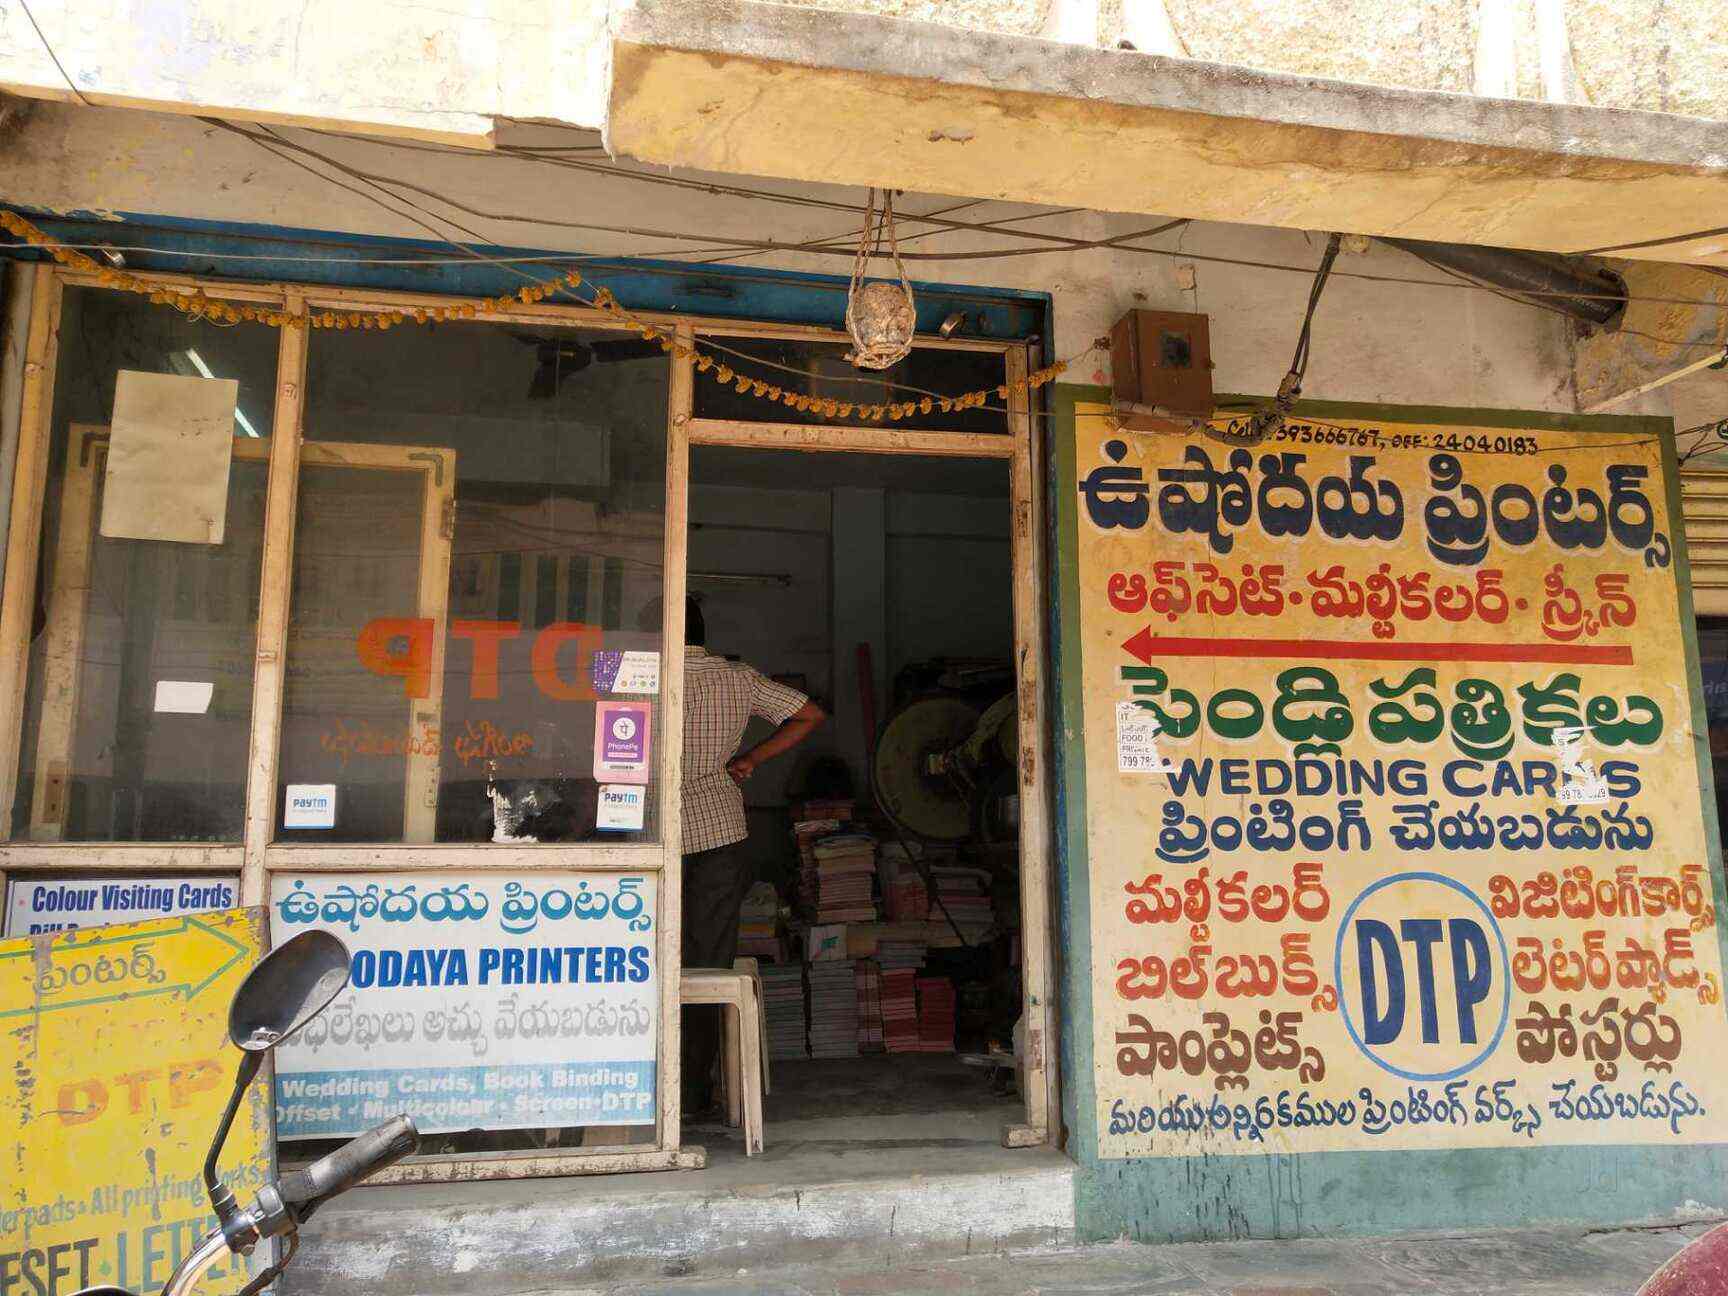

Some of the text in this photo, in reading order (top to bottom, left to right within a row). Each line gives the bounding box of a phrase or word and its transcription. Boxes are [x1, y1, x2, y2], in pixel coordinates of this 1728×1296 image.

[1433, 434, 1538, 455] 24040183
[1079, 439, 1671, 568] ఉషోదయ ప్రింటర్స్
[1120, 666, 1354, 759] పెండ్లి
[607, 742, 638, 750] PhonePe
[1163, 758, 1641, 799] WEDDING CARS
[1155, 800, 1654, 863] ప్రింటింగ్ చేయబడును
[32, 882, 233, 912] Colour Visiting Cards
[275, 877, 651, 935] ఉషోదయ ప్రింటర్స్
[351, 945, 650, 988] ODAYA PRINTERS
[1355, 918, 1493, 1045] DTP
[282, 995, 416, 1053] భలేఖలు
[57, 1058, 226, 1126] DTP
[282, 1068, 639, 1100] Wedding Cards, Book Binding
